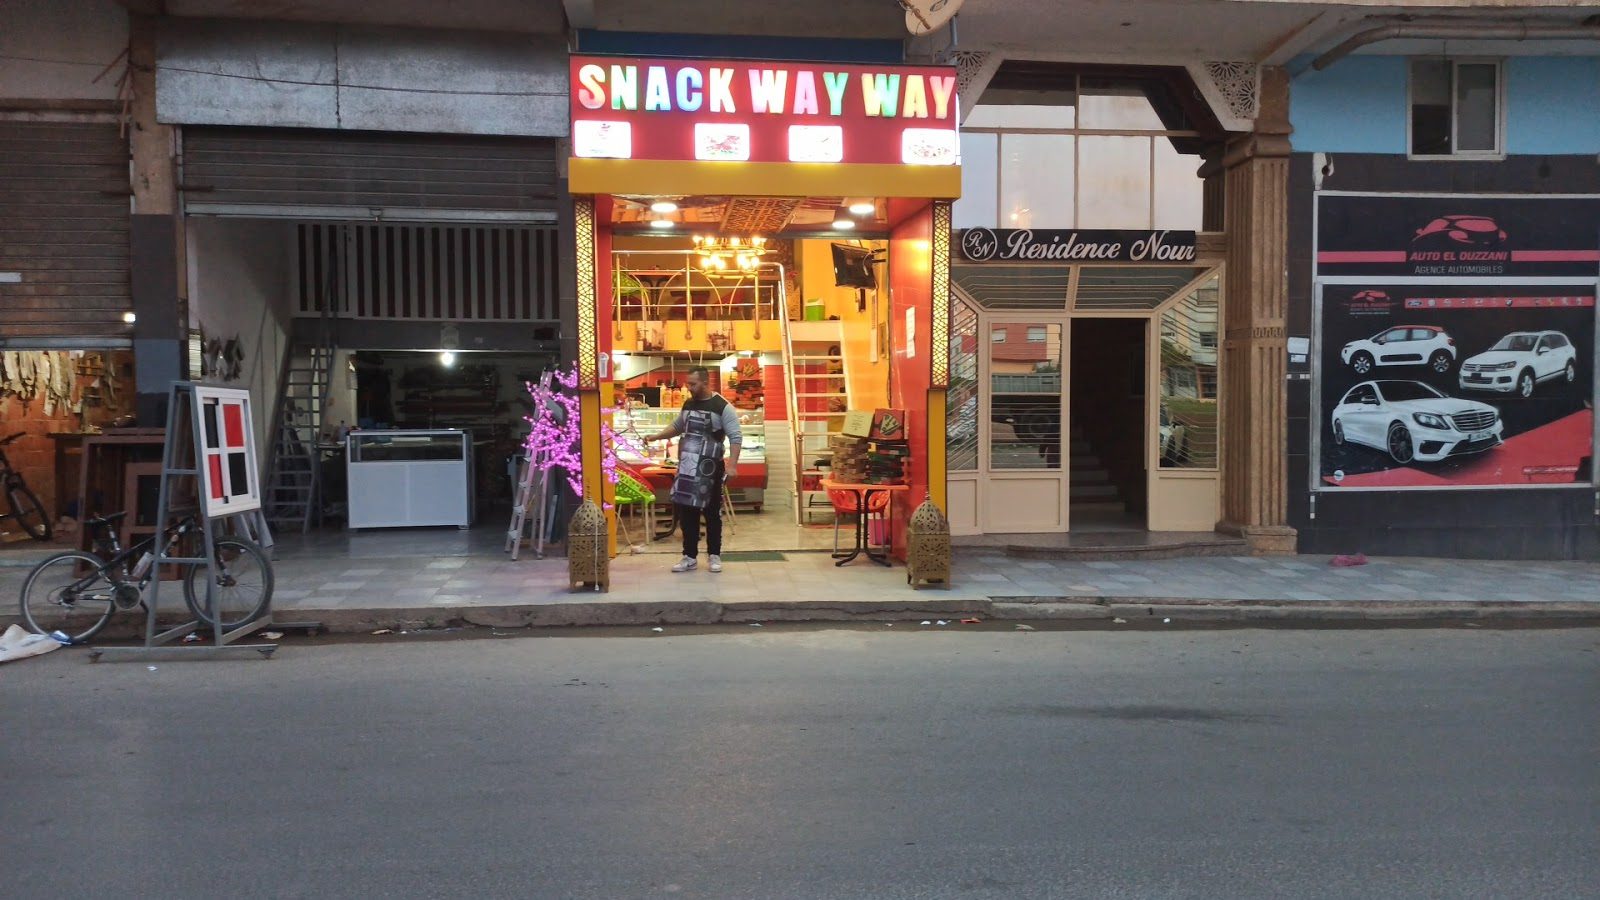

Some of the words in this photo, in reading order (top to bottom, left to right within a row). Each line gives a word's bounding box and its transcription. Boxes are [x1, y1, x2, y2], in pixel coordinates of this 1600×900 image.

[579, 64, 736, 113] SNACK
[748, 69, 848, 116] WAY
[861, 73, 956, 119] WAY
[1000, 229, 1121, 259] Residence
[1130, 230, 1195, 260] Nour
[1410, 252, 1441, 261] AUTO
[1443, 252, 1457, 261] EL
[1460, 252, 1508, 261] OUZZANI
[1414, 265, 1446, 274] AGENCE
[1448, 265, 1503, 274] AUTOMOBILES
